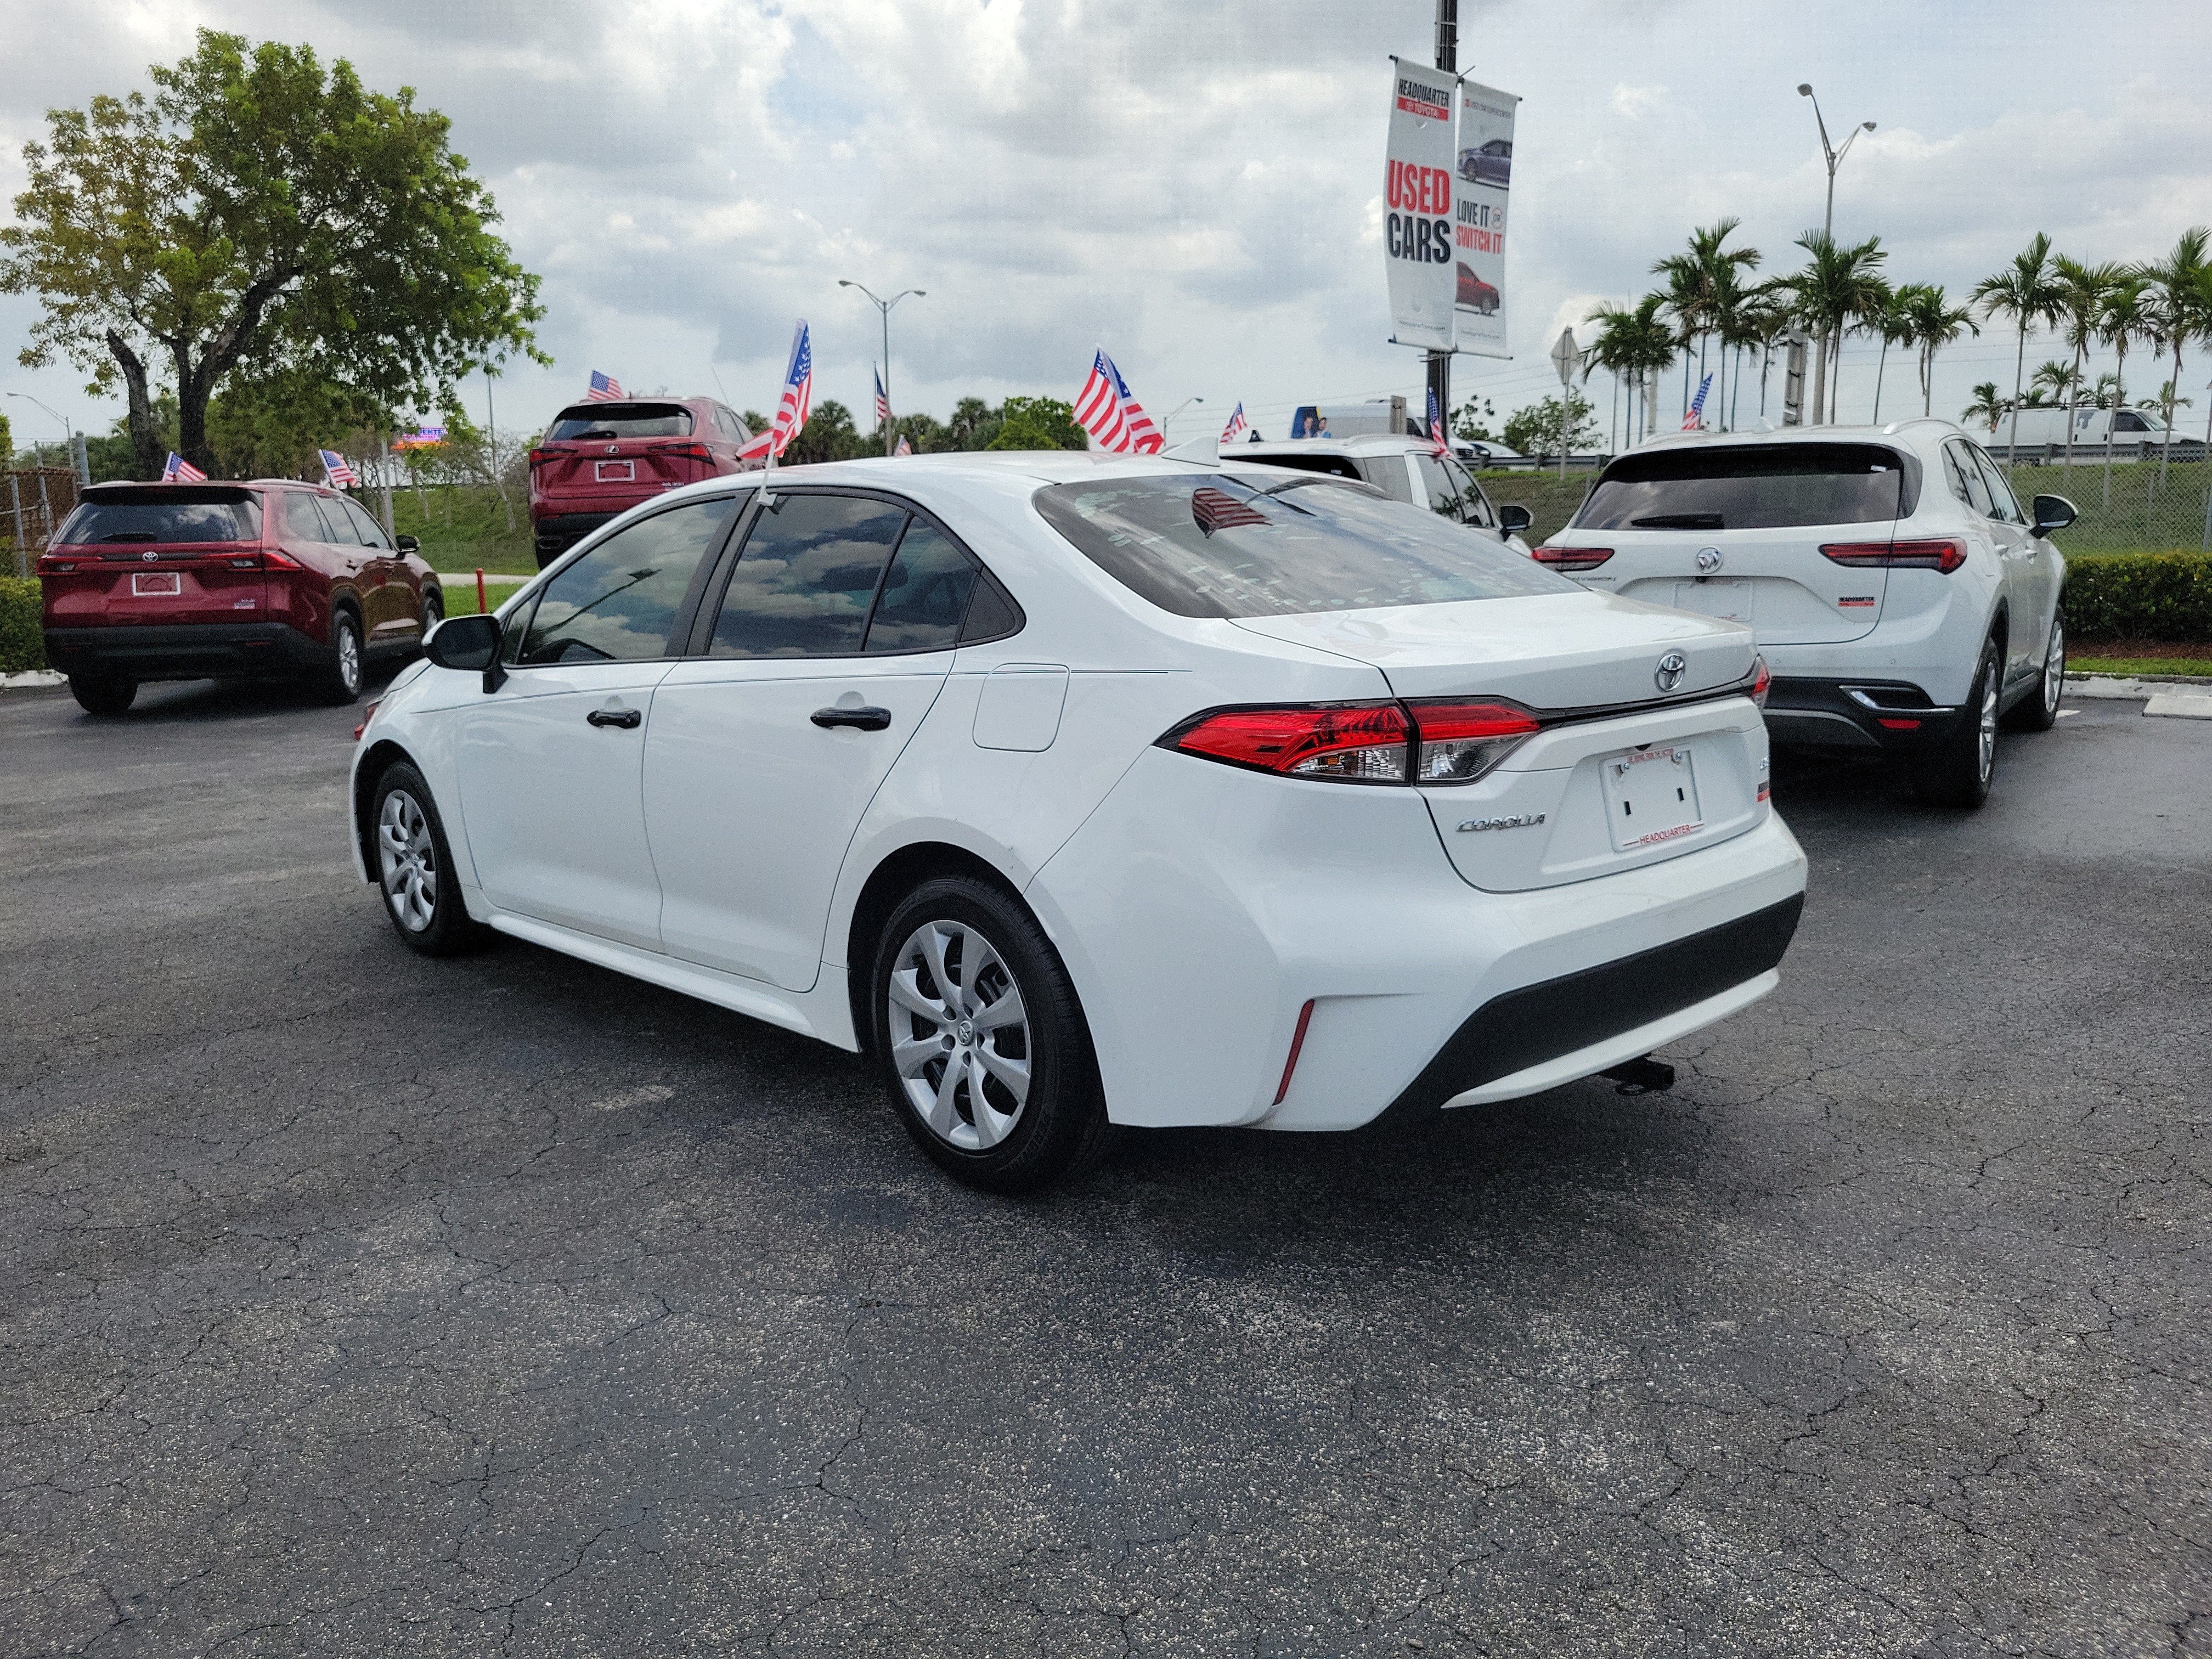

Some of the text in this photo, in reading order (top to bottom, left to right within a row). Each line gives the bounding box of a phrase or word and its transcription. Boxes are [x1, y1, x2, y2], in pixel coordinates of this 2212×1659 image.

[1397, 78, 1449, 108] HEADQUARTER
[1387, 159, 1451, 216] USED
[1457, 198, 1477, 225] LOVE
[1480, 205, 1489, 228] IT
[1387, 212, 1451, 263] CARS
[1456, 225, 1502, 255] SWITCH IT
[1455, 811, 1546, 832] COROLLA
[1639, 824, 1691, 845] HEADQUARTER
